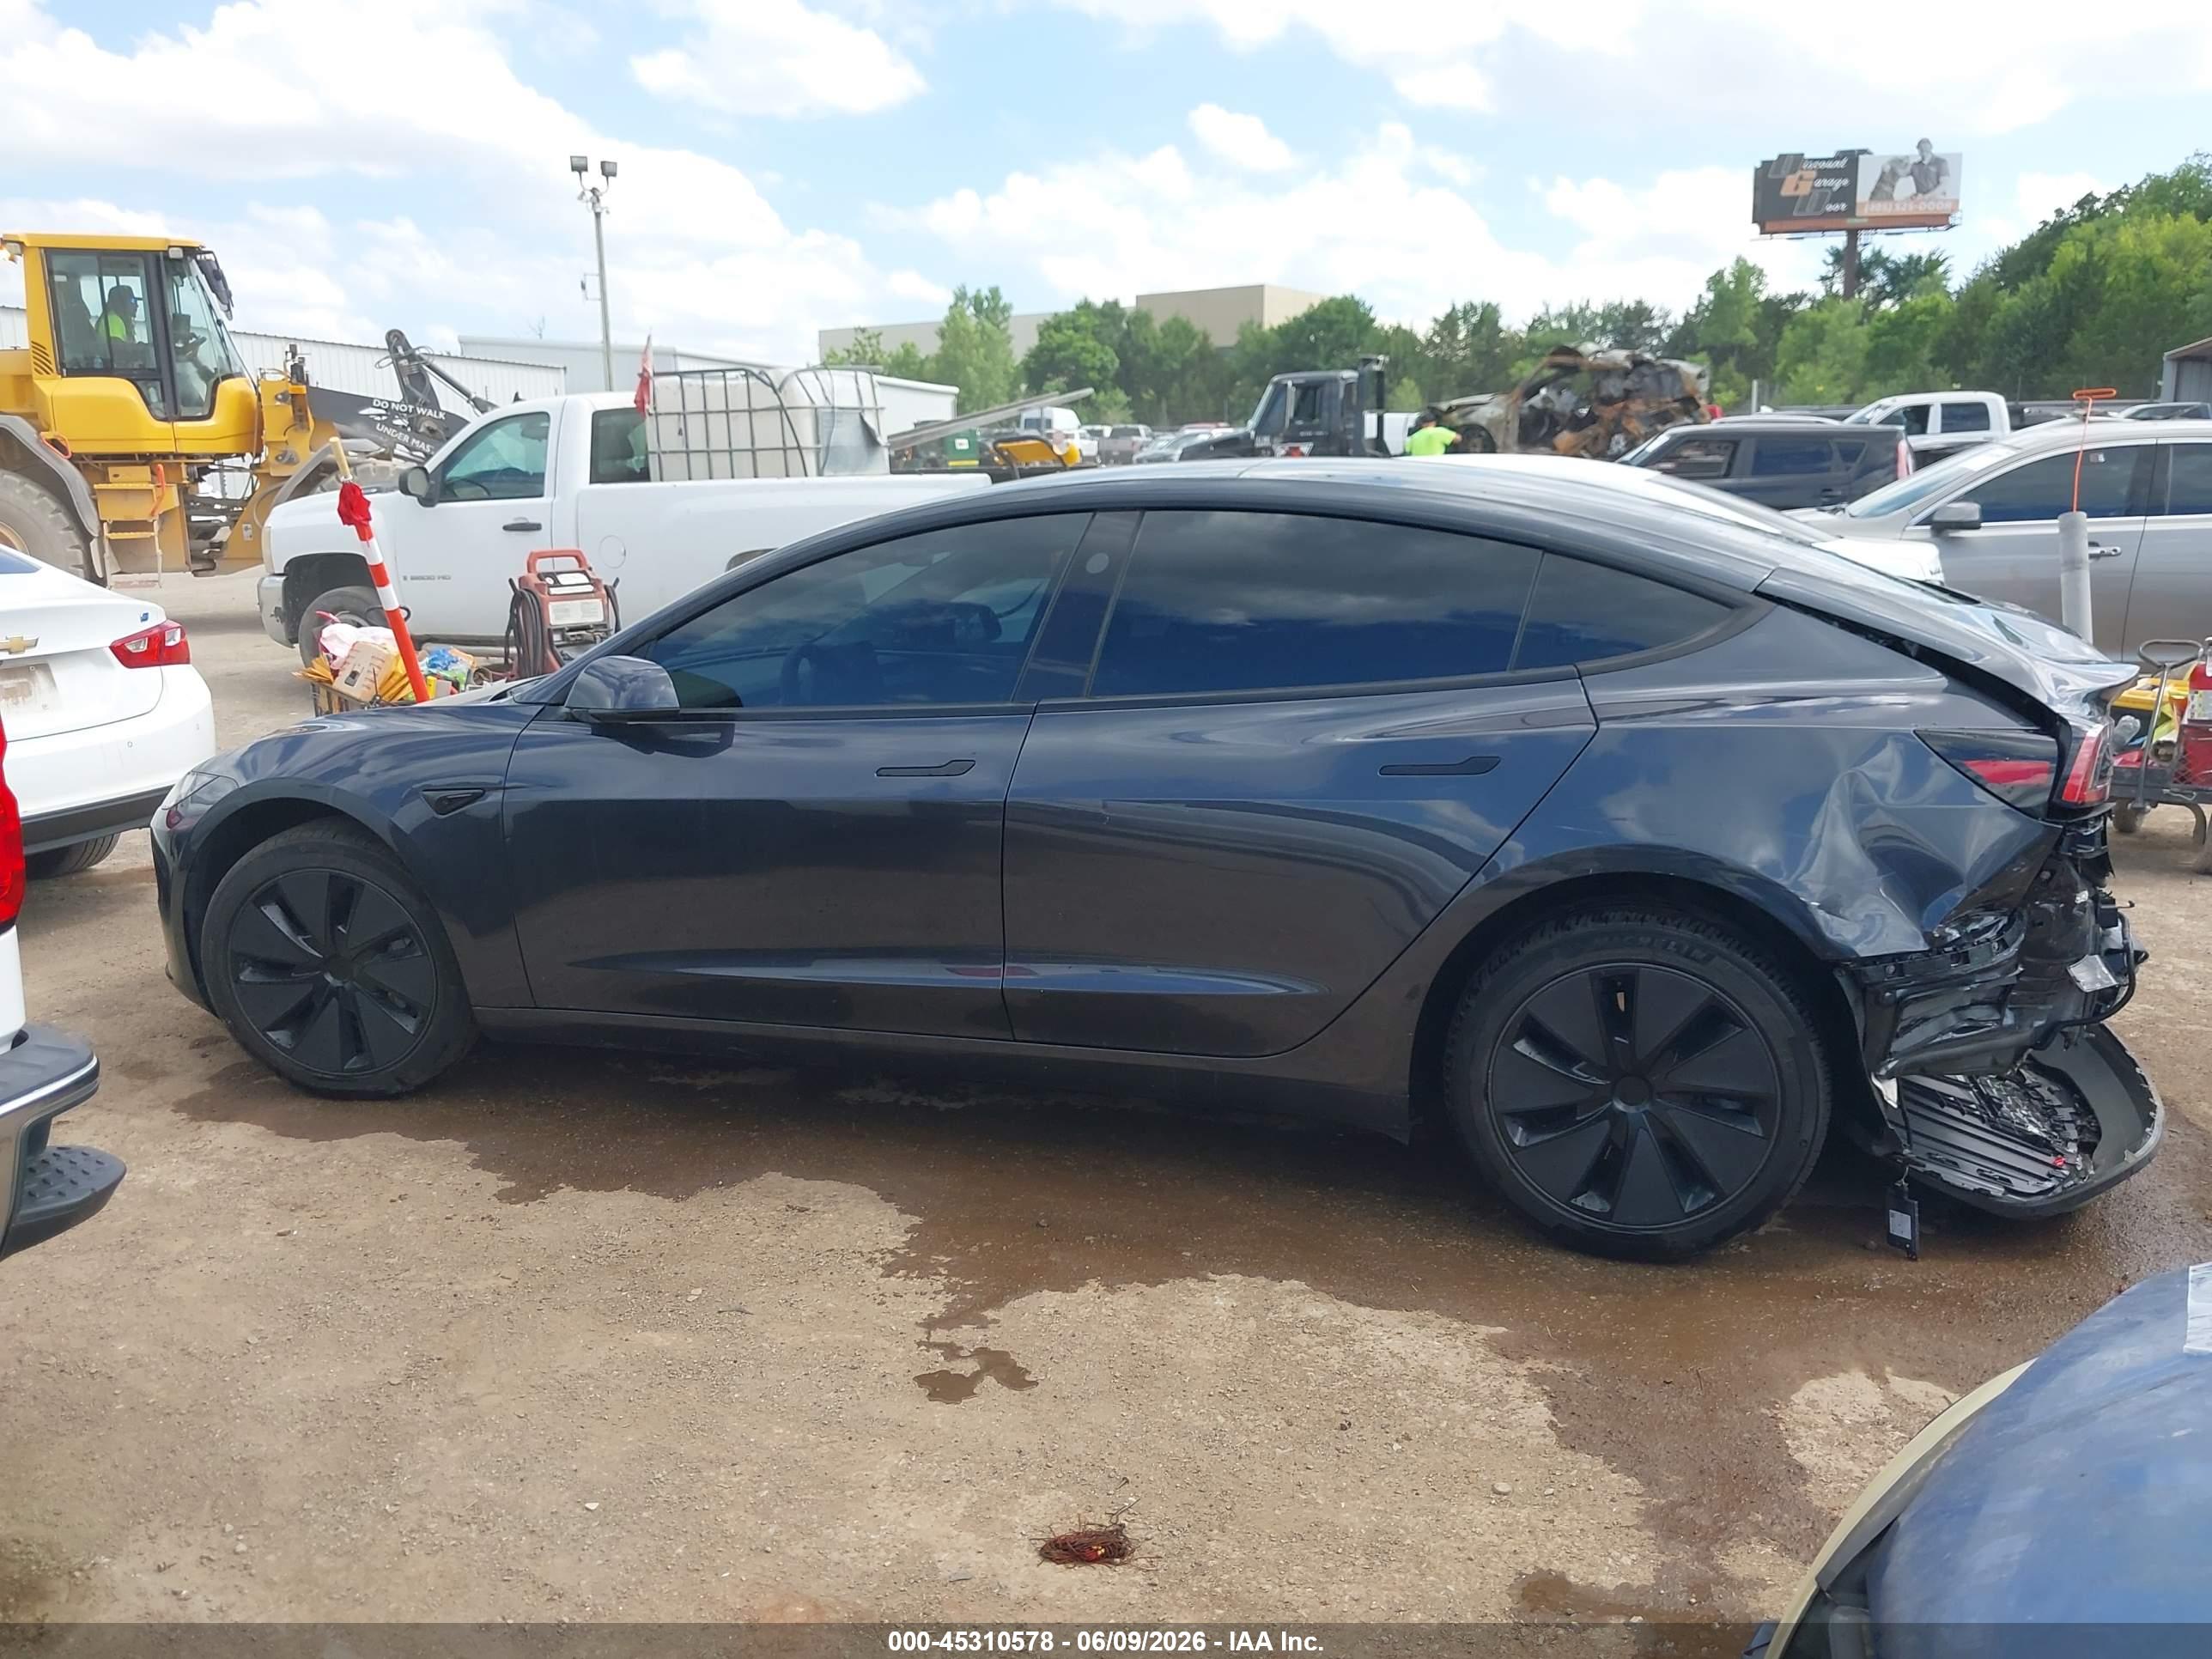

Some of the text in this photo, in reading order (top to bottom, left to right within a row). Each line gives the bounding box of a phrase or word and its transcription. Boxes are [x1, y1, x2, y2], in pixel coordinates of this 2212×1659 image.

[373, 398, 447, 420] DO NOT WALK
[376, 422, 410, 443] UNDER
